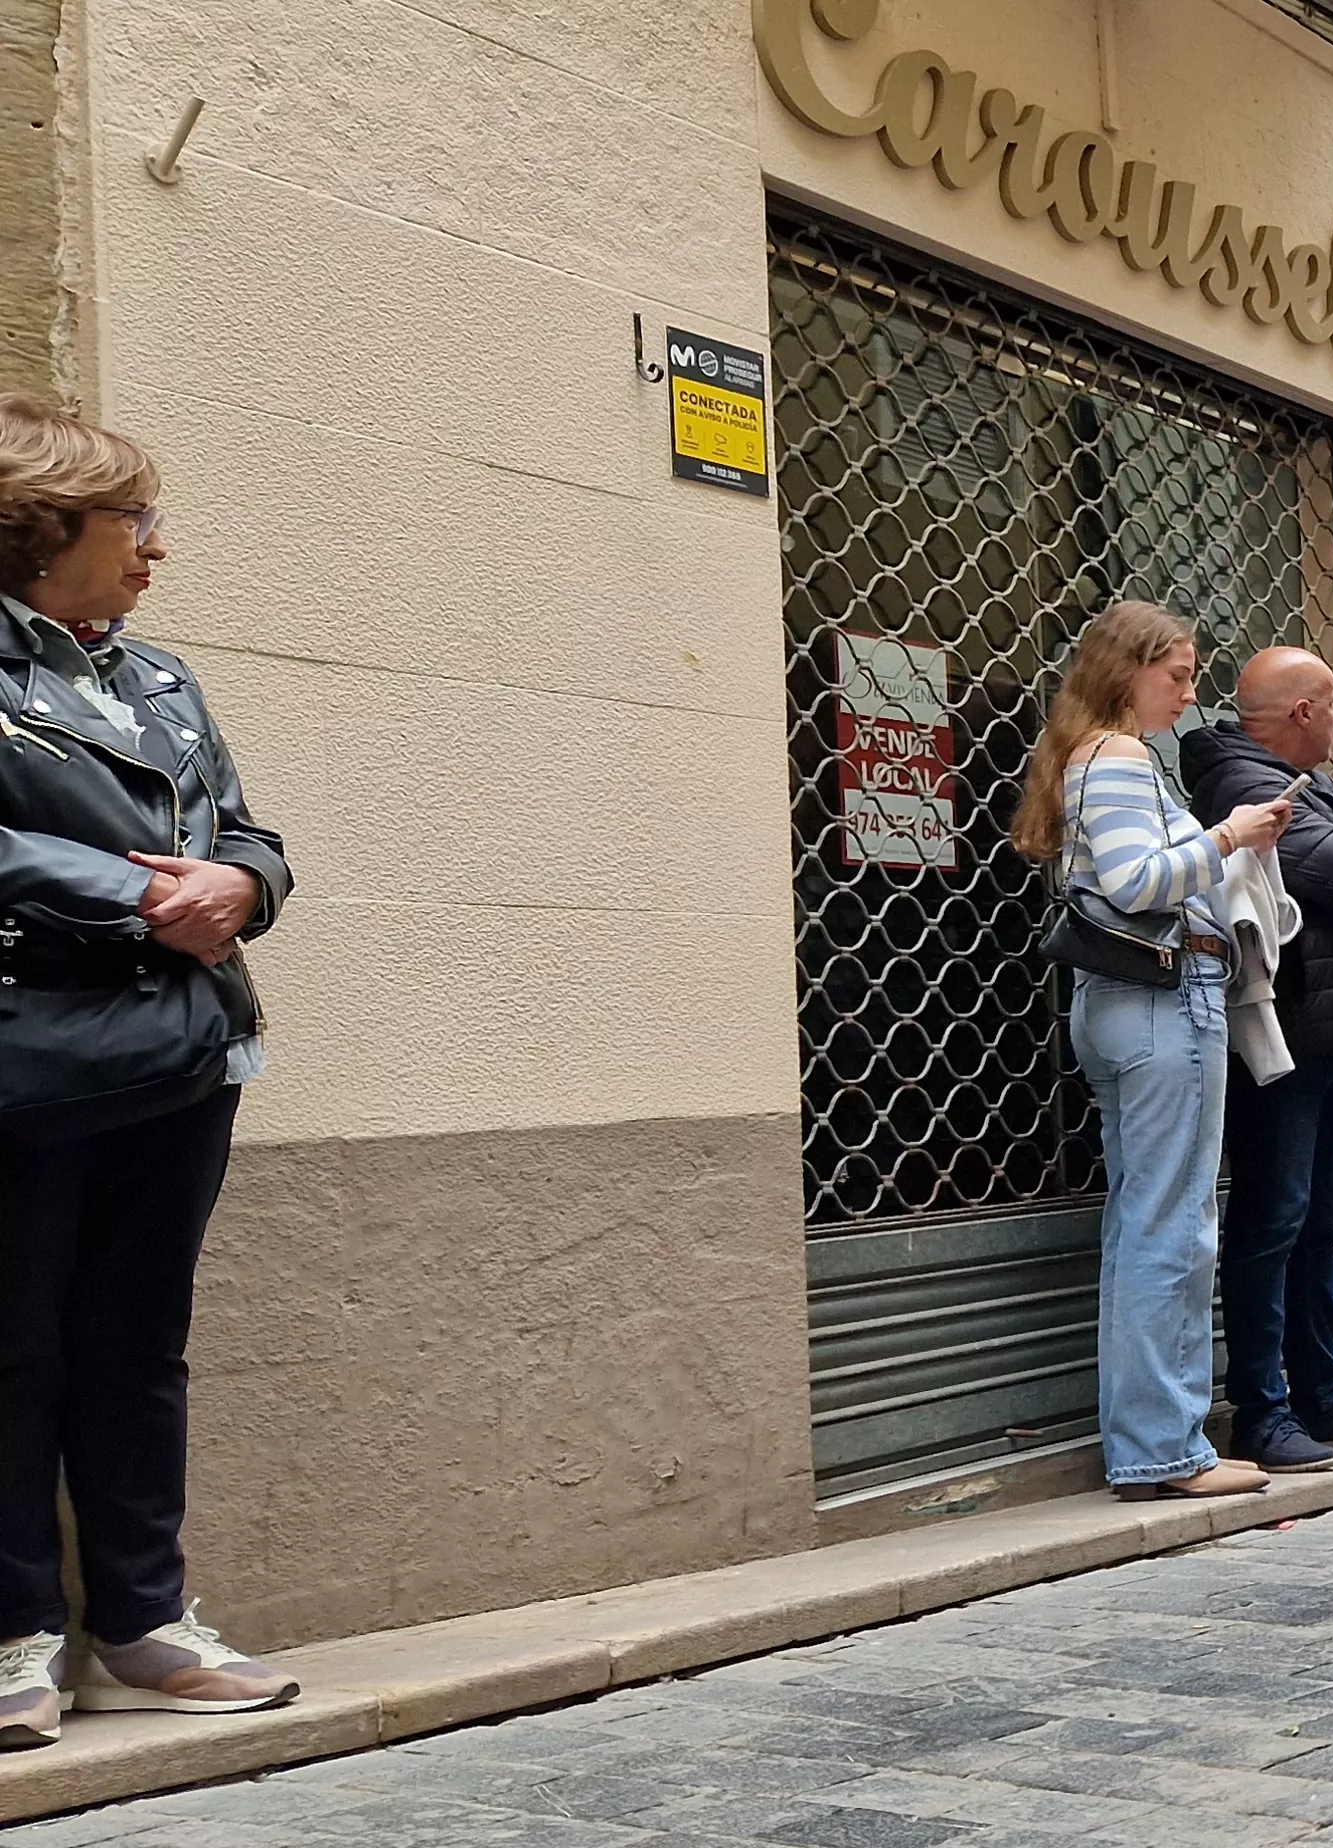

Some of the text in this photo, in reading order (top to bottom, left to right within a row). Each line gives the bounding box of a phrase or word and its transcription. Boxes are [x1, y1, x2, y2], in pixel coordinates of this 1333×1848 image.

[679, 390, 758, 422] CONECTADA
[679, 405, 698, 417] CON
[698, 411, 722, 424] AVISO
[854, 723, 935, 759] VENDE
[861, 760, 935, 798] LOCAL
